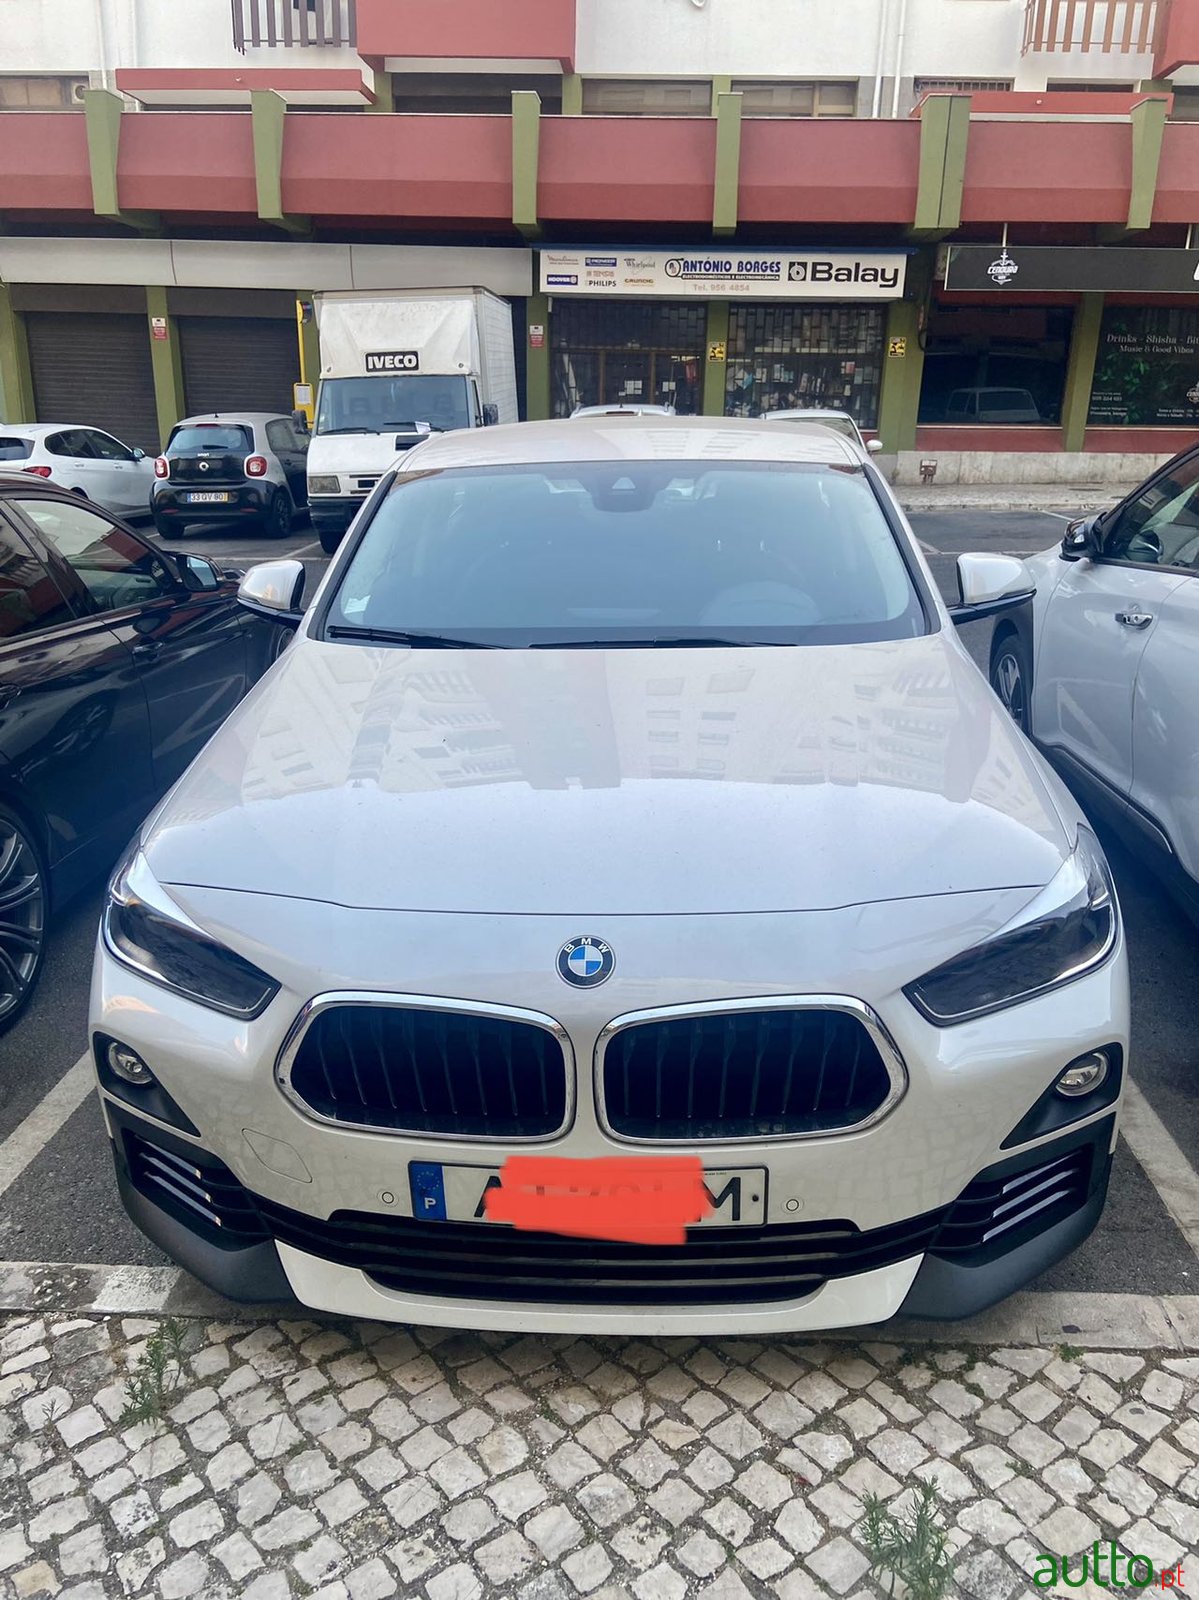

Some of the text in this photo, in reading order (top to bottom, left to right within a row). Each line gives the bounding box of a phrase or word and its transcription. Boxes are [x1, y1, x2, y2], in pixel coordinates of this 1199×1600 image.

[683, 257, 781, 273] ANTÓNIO BORGES
[811, 262, 899, 288] Balay
[1107, 334, 1137, 343] Drinks
[367, 354, 417, 369] IVECO
[564, 938, 610, 953] BMW
[424, 1197, 436, 1209] P
